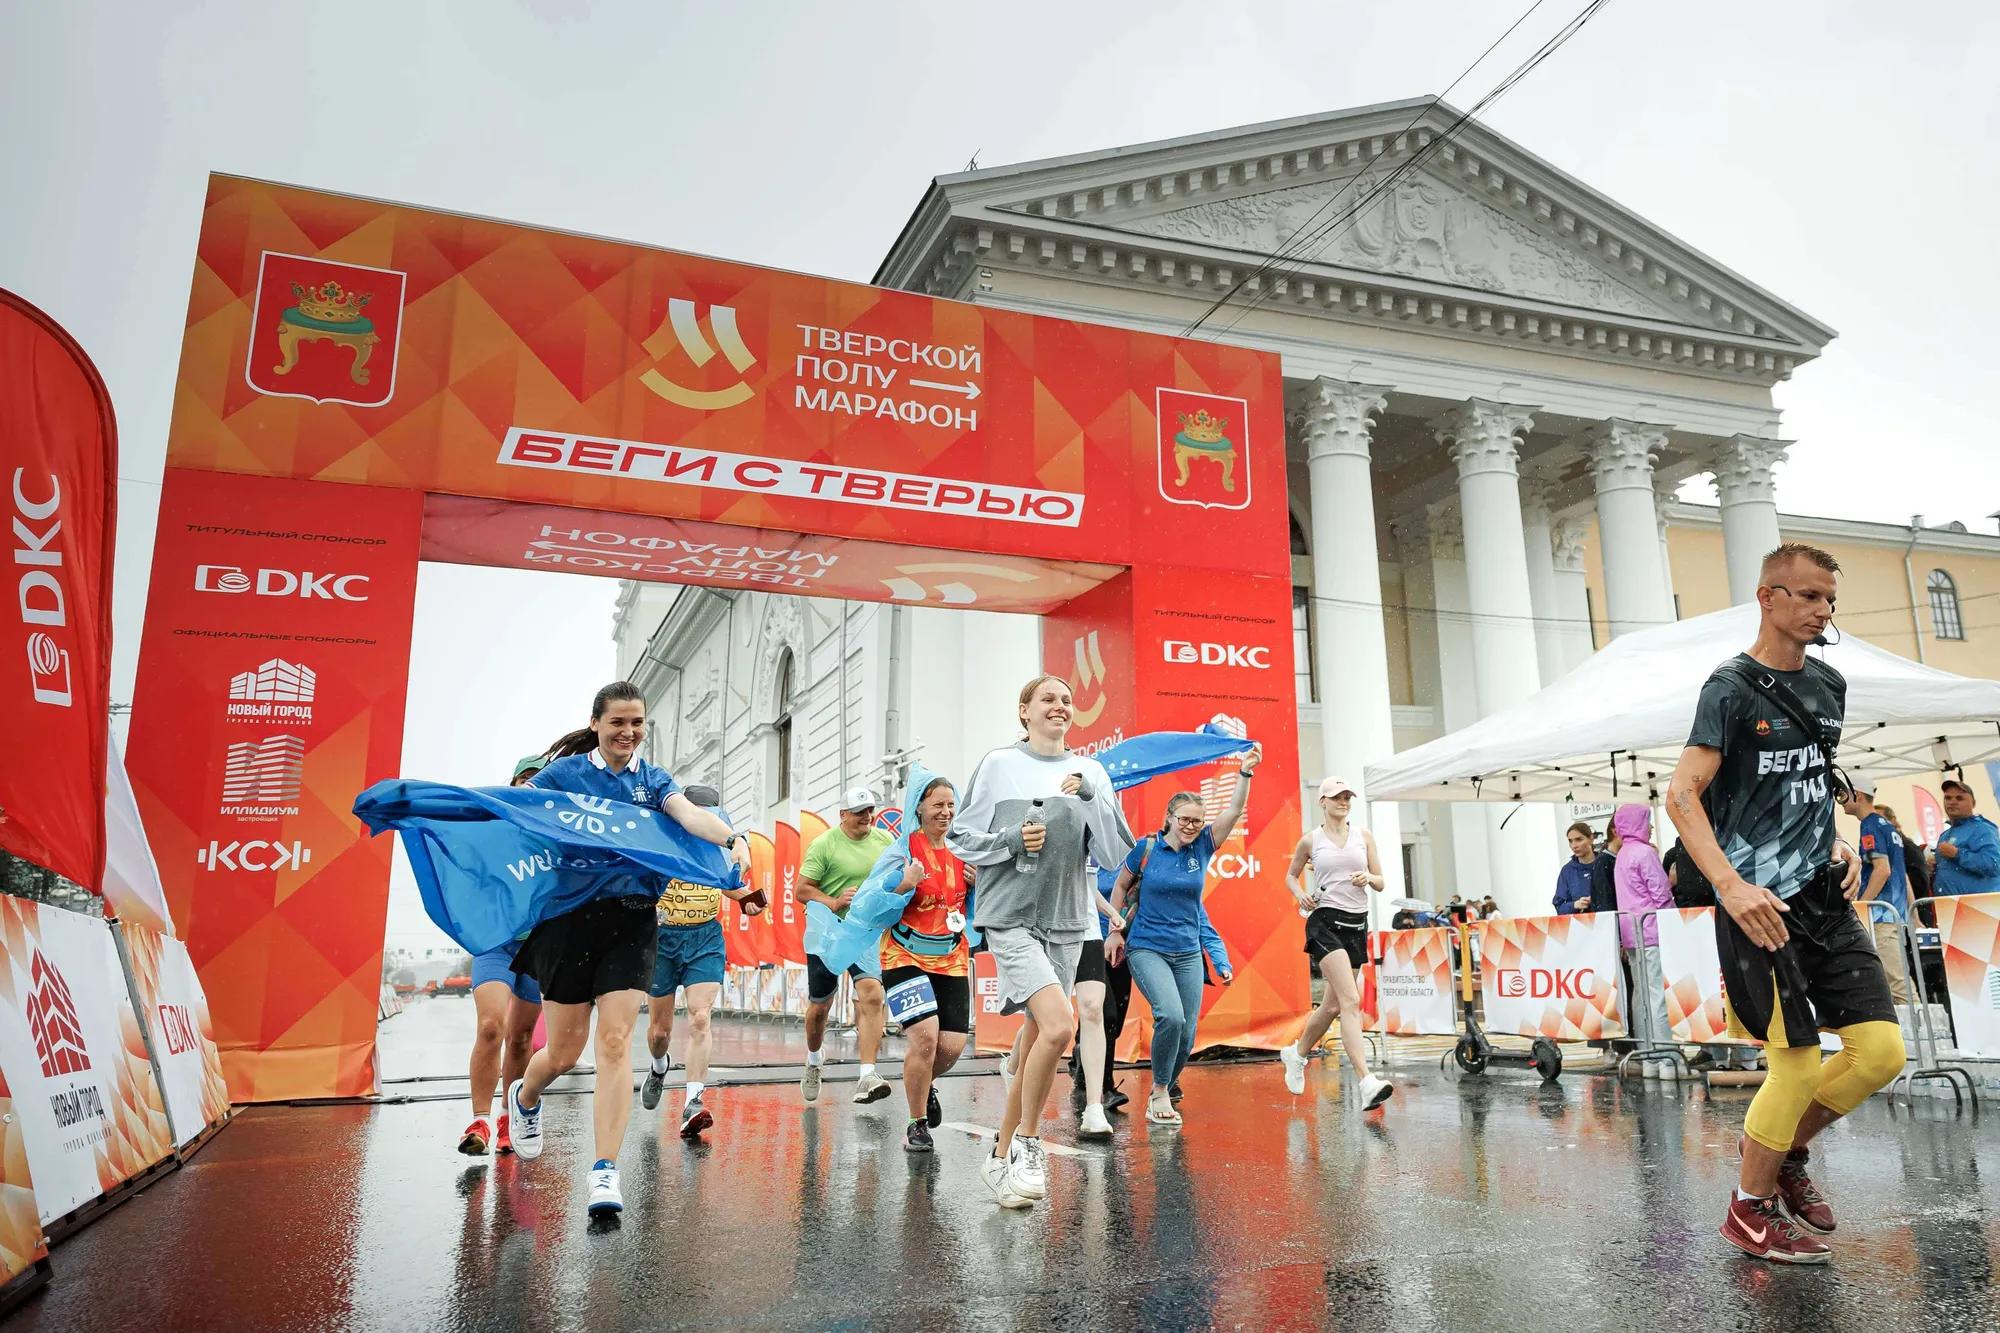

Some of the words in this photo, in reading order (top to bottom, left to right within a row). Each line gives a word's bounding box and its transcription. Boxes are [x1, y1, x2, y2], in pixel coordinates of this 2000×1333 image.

[796, 324, 981, 373] ТВЕРСКОЙ
[796, 355, 897, 389] ПОЛУ
[795, 385, 977, 431] МАРАФОН
[511, 433, 720, 482] БЕГИ
[733, 461, 780, 488] С
[799, 466, 1076, 521] ТВЕРЬЮ
[13, 467, 66, 627] DKC
[186, 524, 298, 540] ТИТУЛЬНЫЙ
[301, 533, 387, 545] СПОНСОР
[540, 525, 839, 567] МАРАФОН
[524, 550, 811, 588] ТВЕРСКОЙ
[671, 556, 826, 578] ПОЛУ
[256, 568, 370, 602] DKC
[1154, 609, 1222, 621] ТИТУЛЬНЫЙ
[1224, 615, 1276, 624] СПОНСОР
[172, 628, 291, 641] ОФИЦИАЛЬНЫЕ
[294, 635, 377, 646] СПОНСОРЫ
[1200, 643, 1271, 669] DKC
[227, 702, 272, 716] НОВЫЙ
[274, 705, 313, 719] ГОРОД
[220, 806, 299, 815] ИЛЛИДИУМ
[783, 864, 795, 904] DKC
[1531, 968, 1597, 999] DKC
[901, 993, 924, 1011] 221
[50, 1082, 85, 1129] НОВЫЙ
